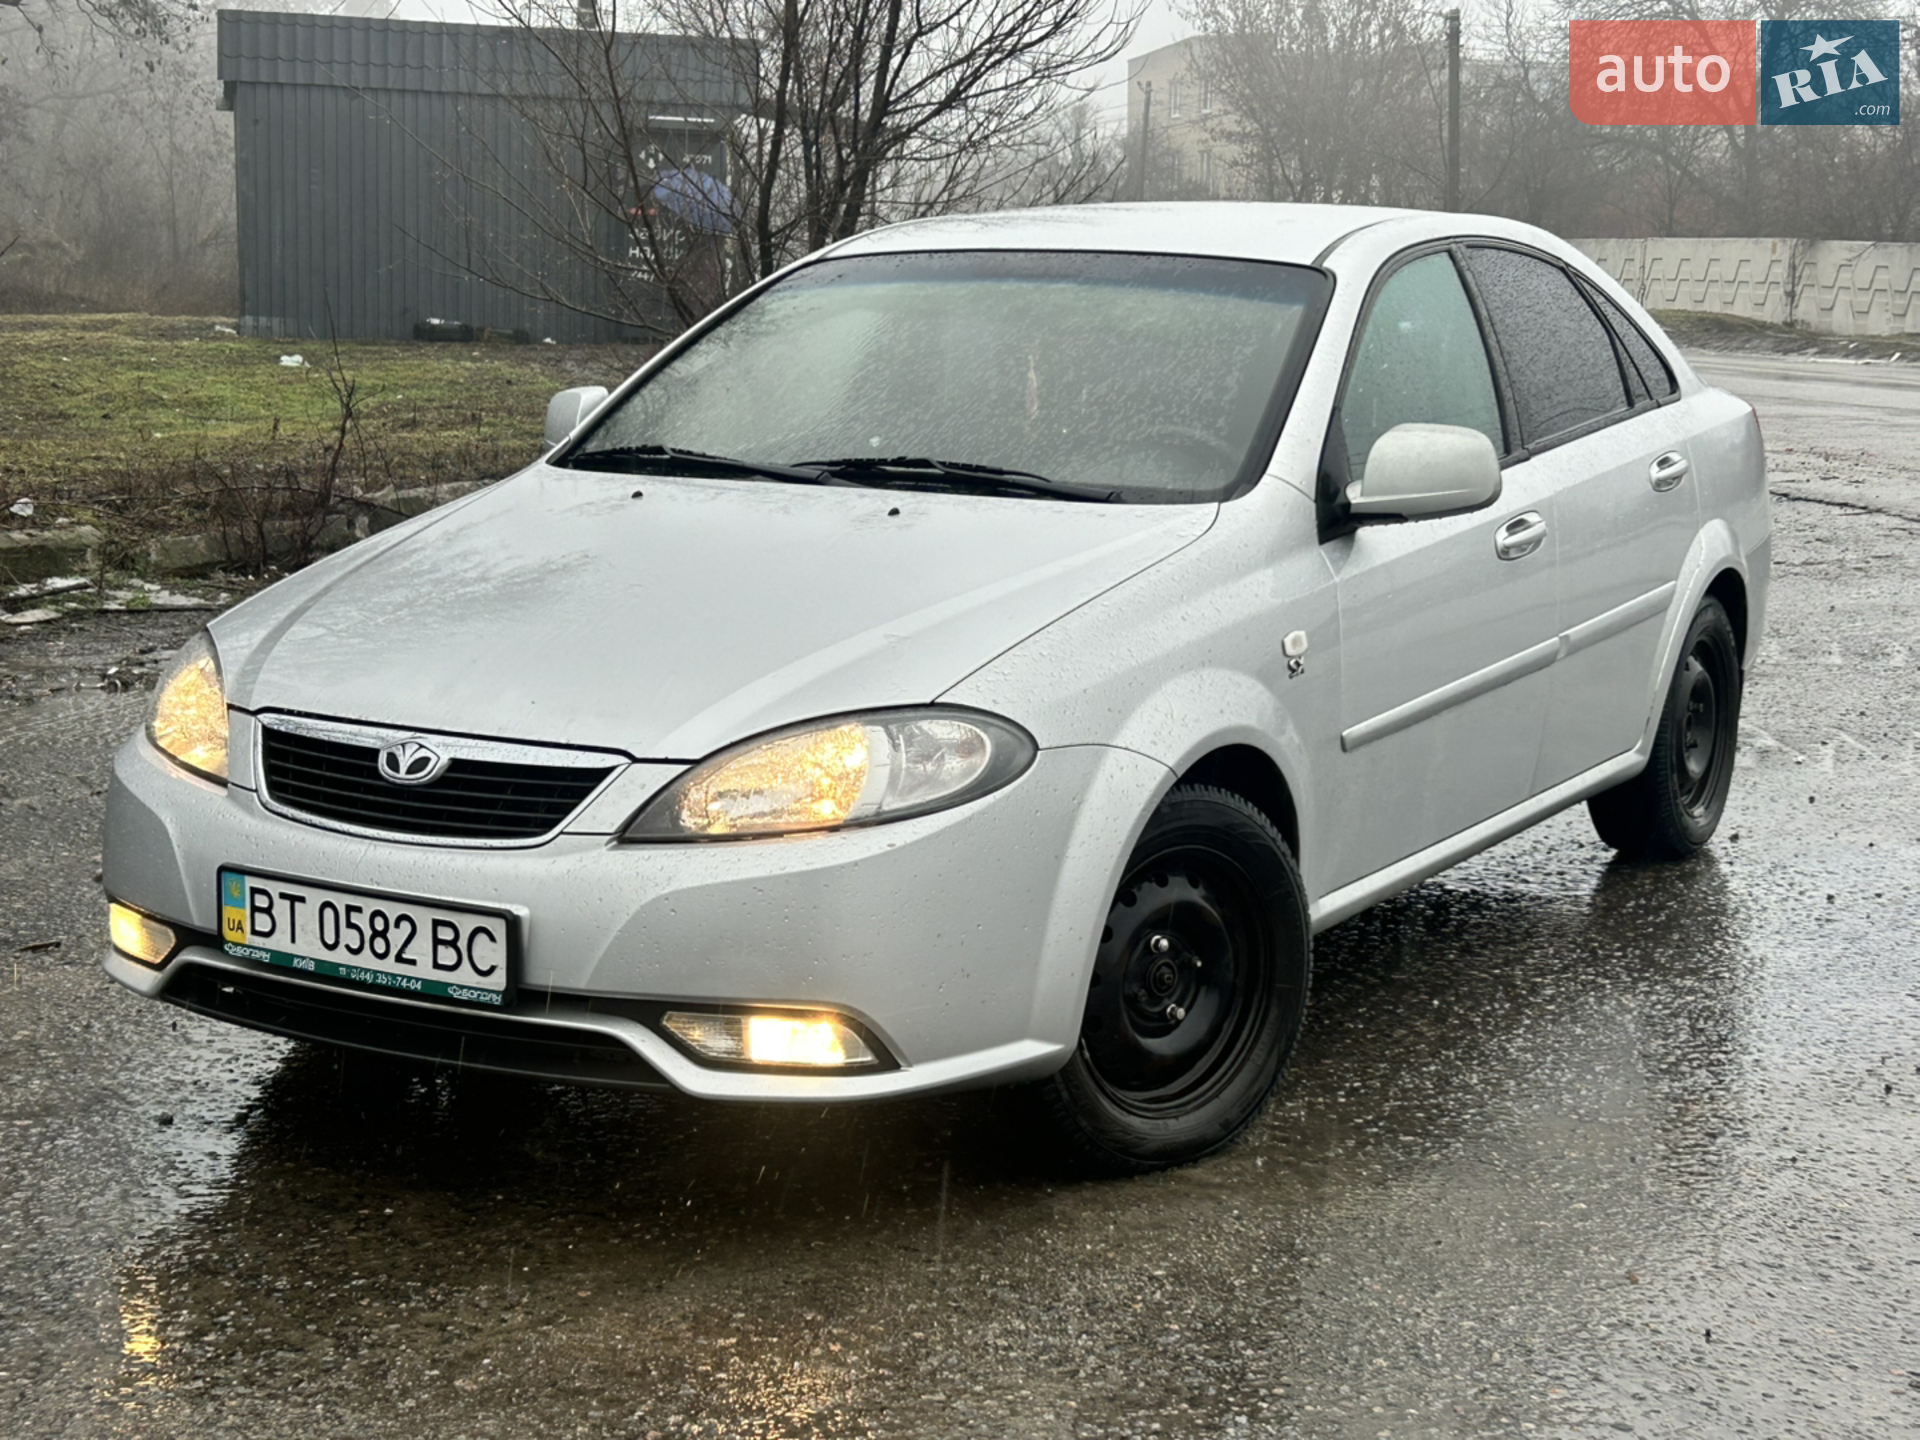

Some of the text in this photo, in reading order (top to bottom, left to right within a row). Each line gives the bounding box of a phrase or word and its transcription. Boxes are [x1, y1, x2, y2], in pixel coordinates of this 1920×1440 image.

[227, 917, 245, 934] UA
[249, 886, 499, 978] BT 0582 BC
